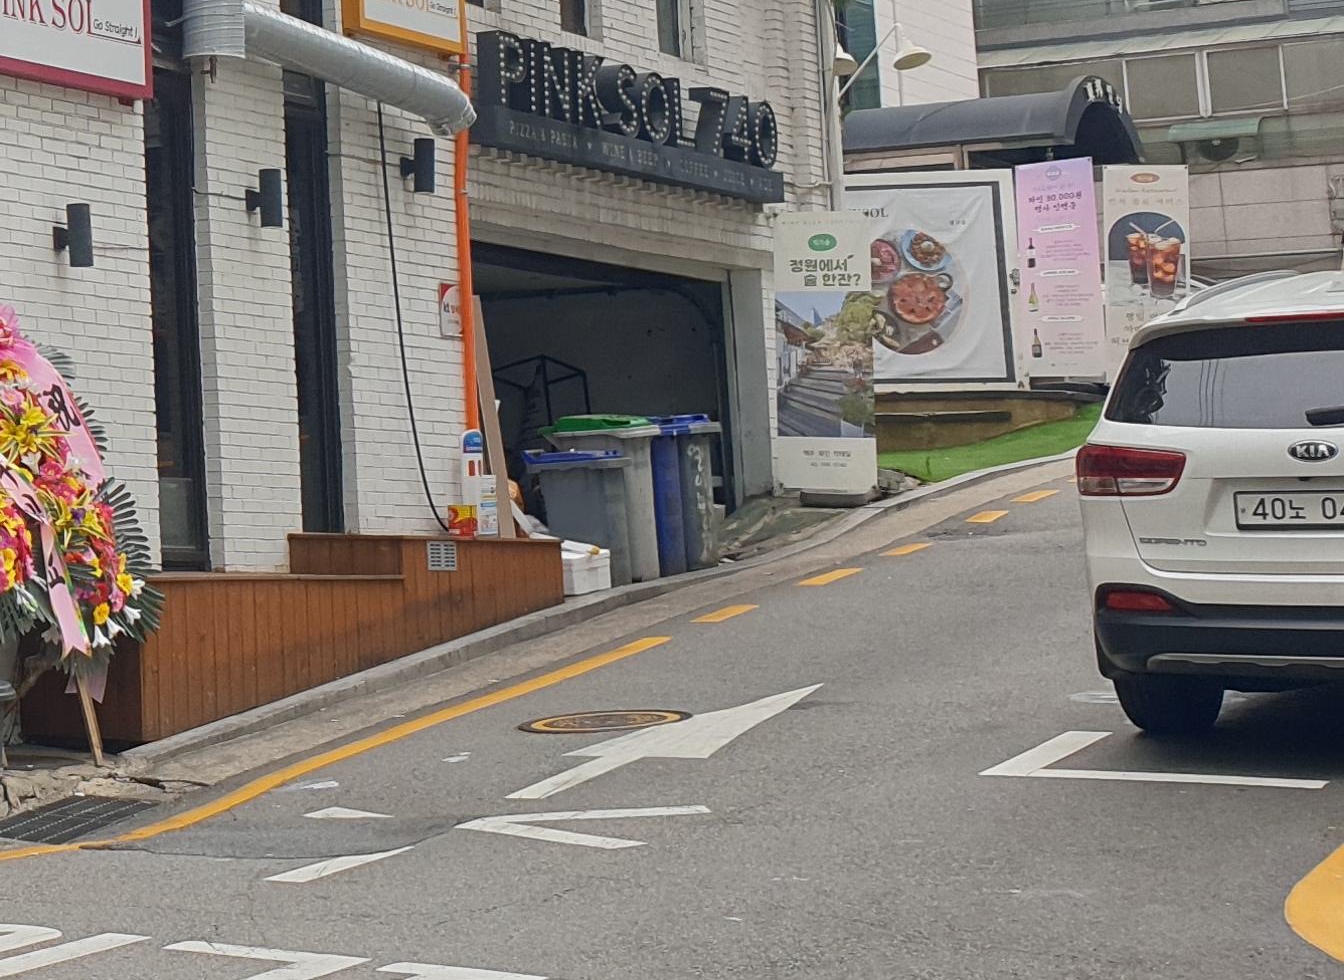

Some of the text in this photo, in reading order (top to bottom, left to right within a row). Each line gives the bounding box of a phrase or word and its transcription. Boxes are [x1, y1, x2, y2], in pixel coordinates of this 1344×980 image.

[93, 19, 105, 33] Go
[710, 88, 779, 168] 740
[509, 122, 537, 141] PIZZA
[550, 131, 578, 149] PASTA
[602, 140, 625, 158] WINE
[789, 258, 848, 273] 정원에서
[1295, 444, 1330, 458] KIA
[1252, 497, 1307, 520] 40노
